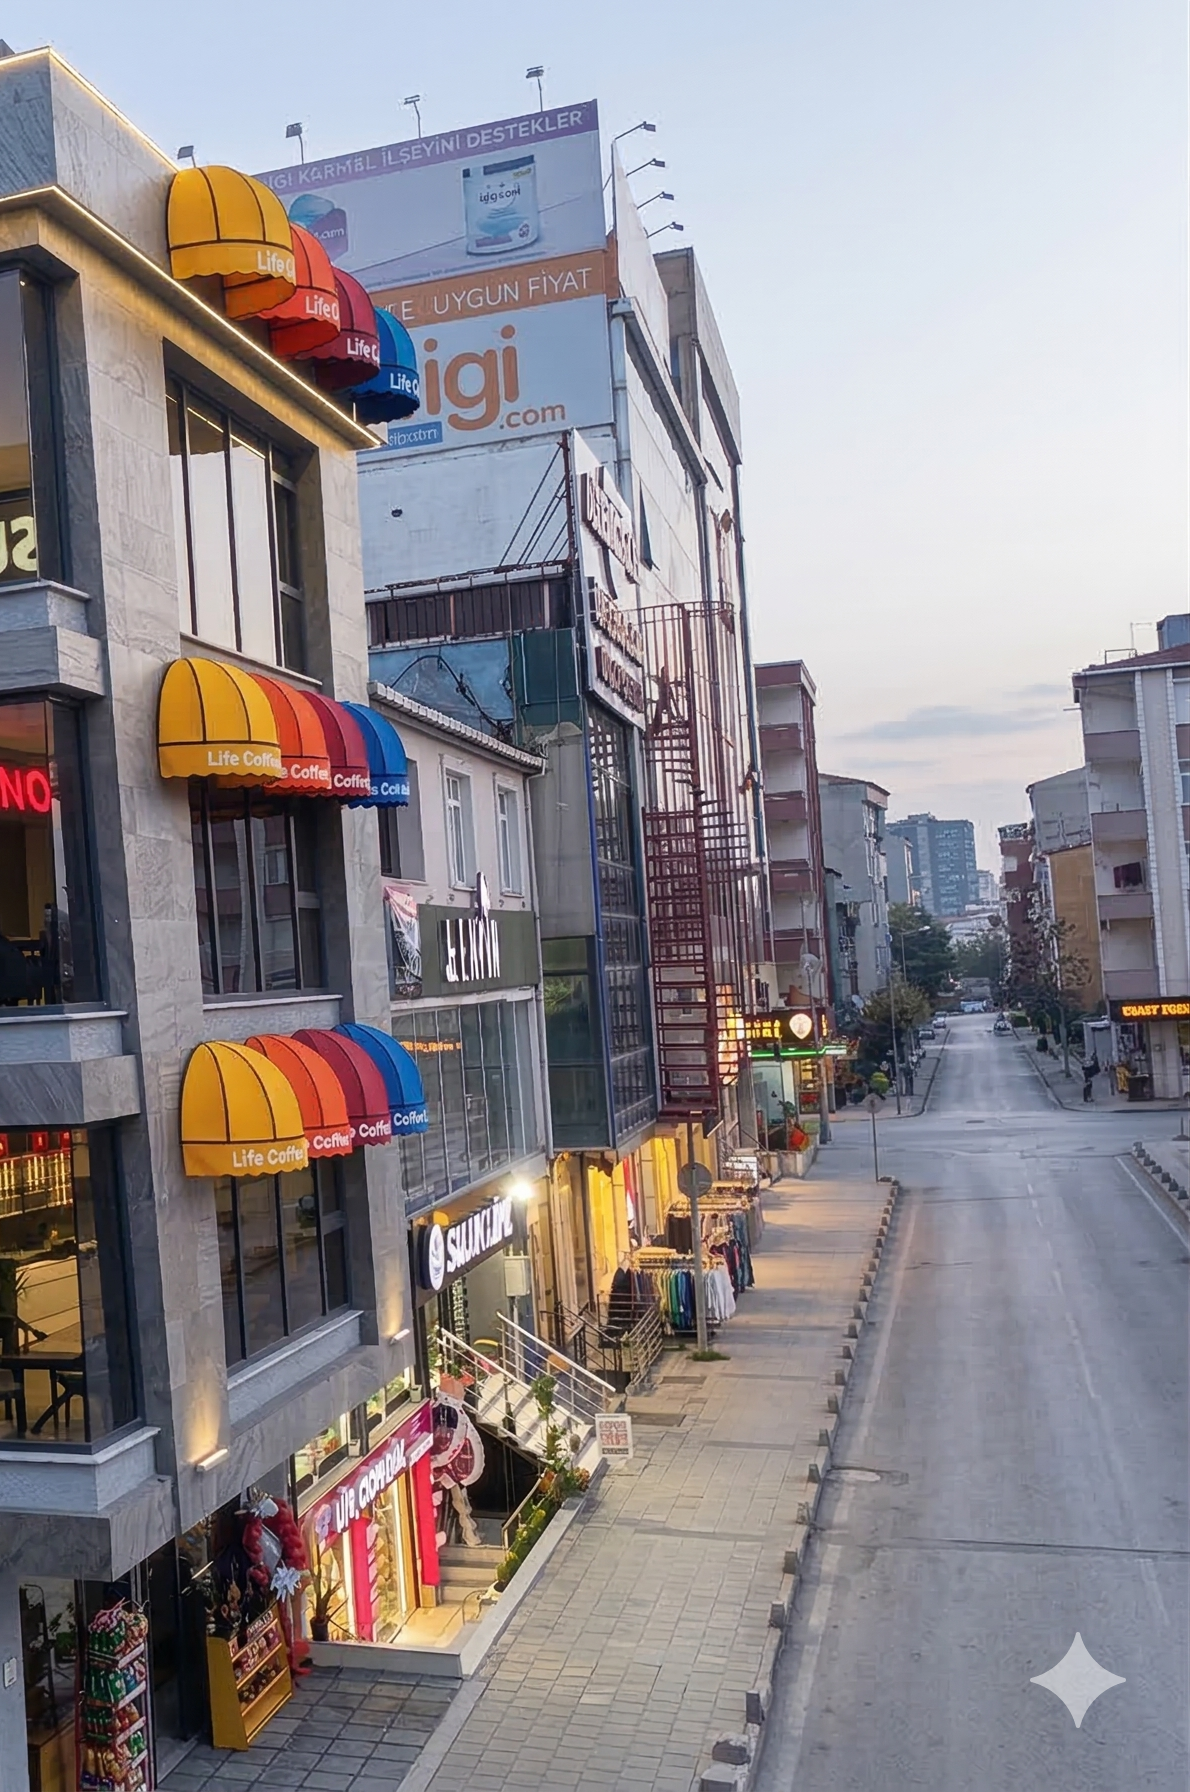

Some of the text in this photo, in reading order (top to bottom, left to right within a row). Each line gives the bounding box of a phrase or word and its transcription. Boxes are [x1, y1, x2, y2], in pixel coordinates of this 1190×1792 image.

[466, 109, 583, 149] DESTEKLER
[257, 250, 285, 273] Life
[433, 280, 519, 315] UYGUN
[528, 267, 593, 300] FİYAT
[305, 294, 331, 318] Life
[346, 337, 371, 359] Life
[390, 372, 412, 393] Life
[207, 751, 240, 766] Life
[232, 1149, 264, 1168] Life
